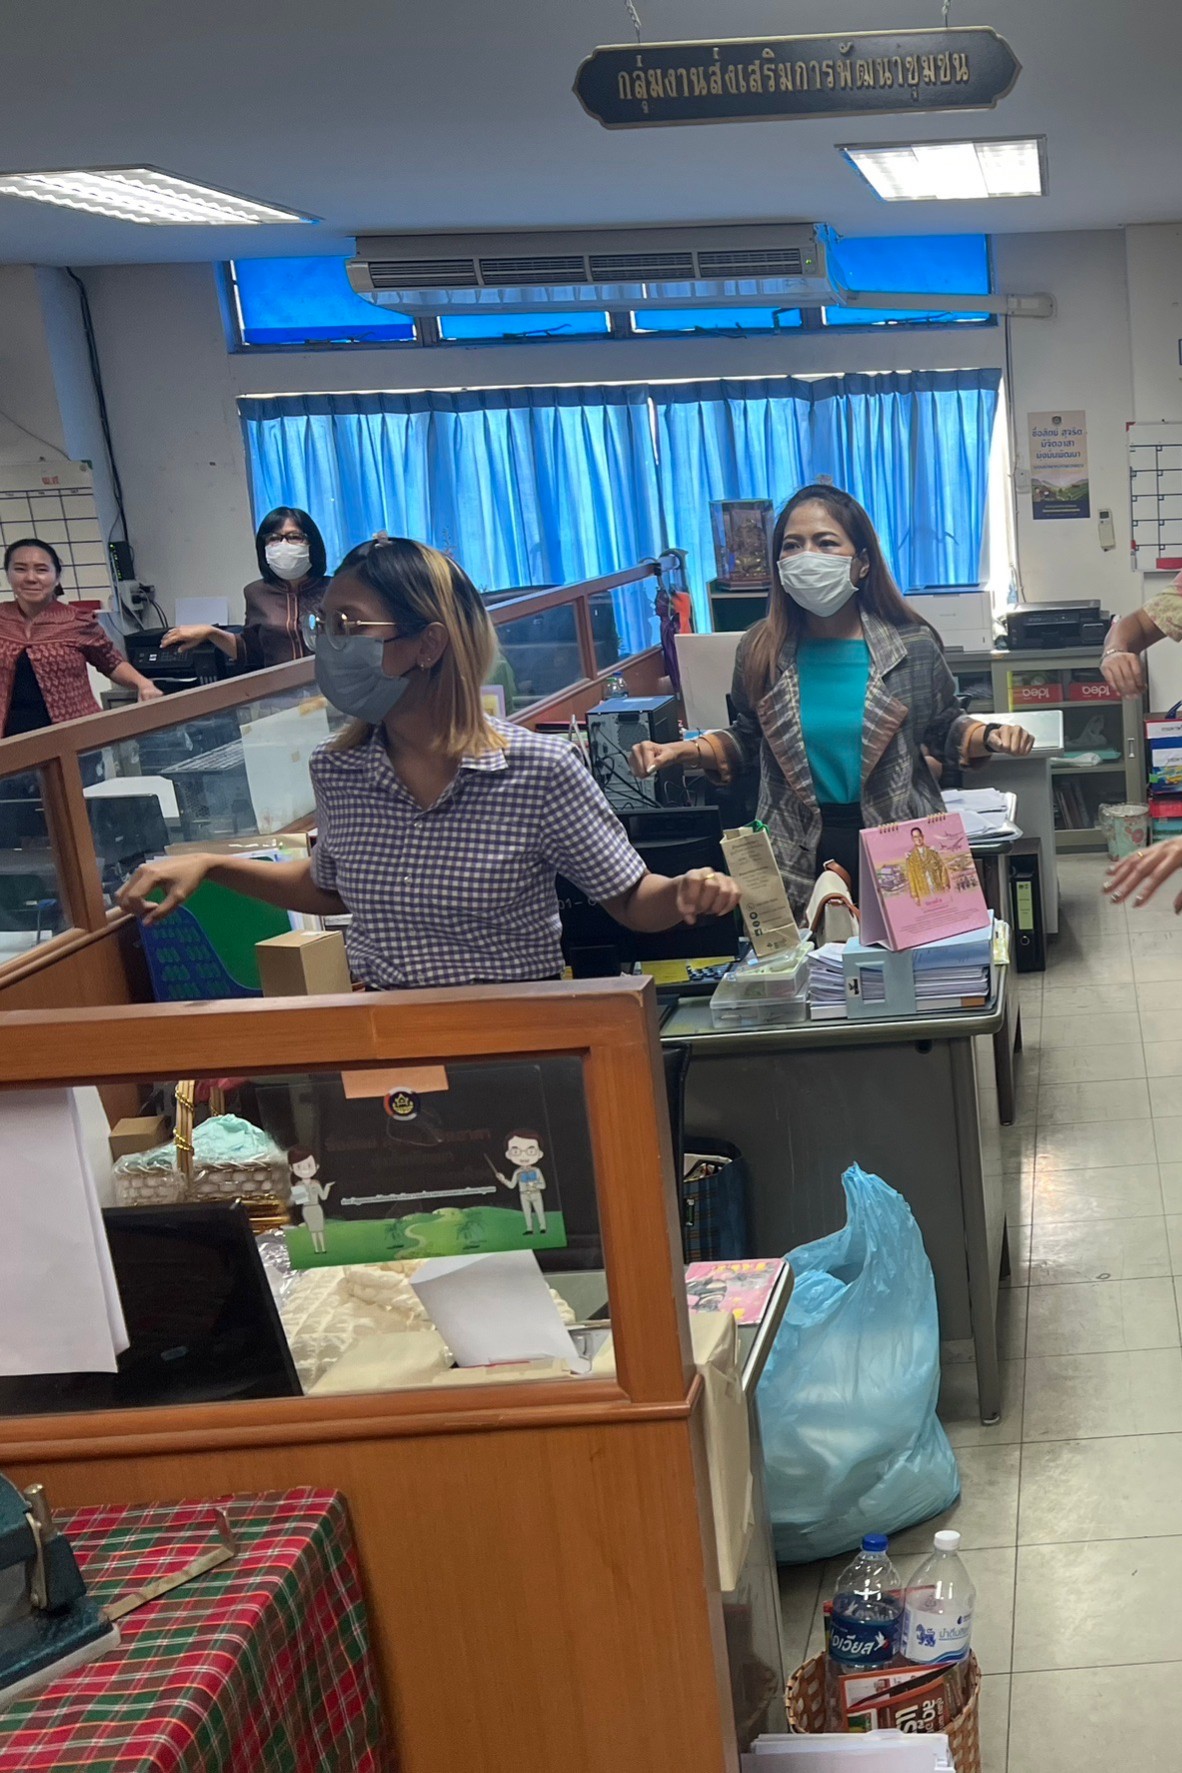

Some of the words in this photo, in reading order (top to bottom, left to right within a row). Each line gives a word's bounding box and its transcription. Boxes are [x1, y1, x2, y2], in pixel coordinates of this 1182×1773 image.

[617, 44, 969, 113] กลุ่มงานส่งเสริมการพัฒนาชุมชน
